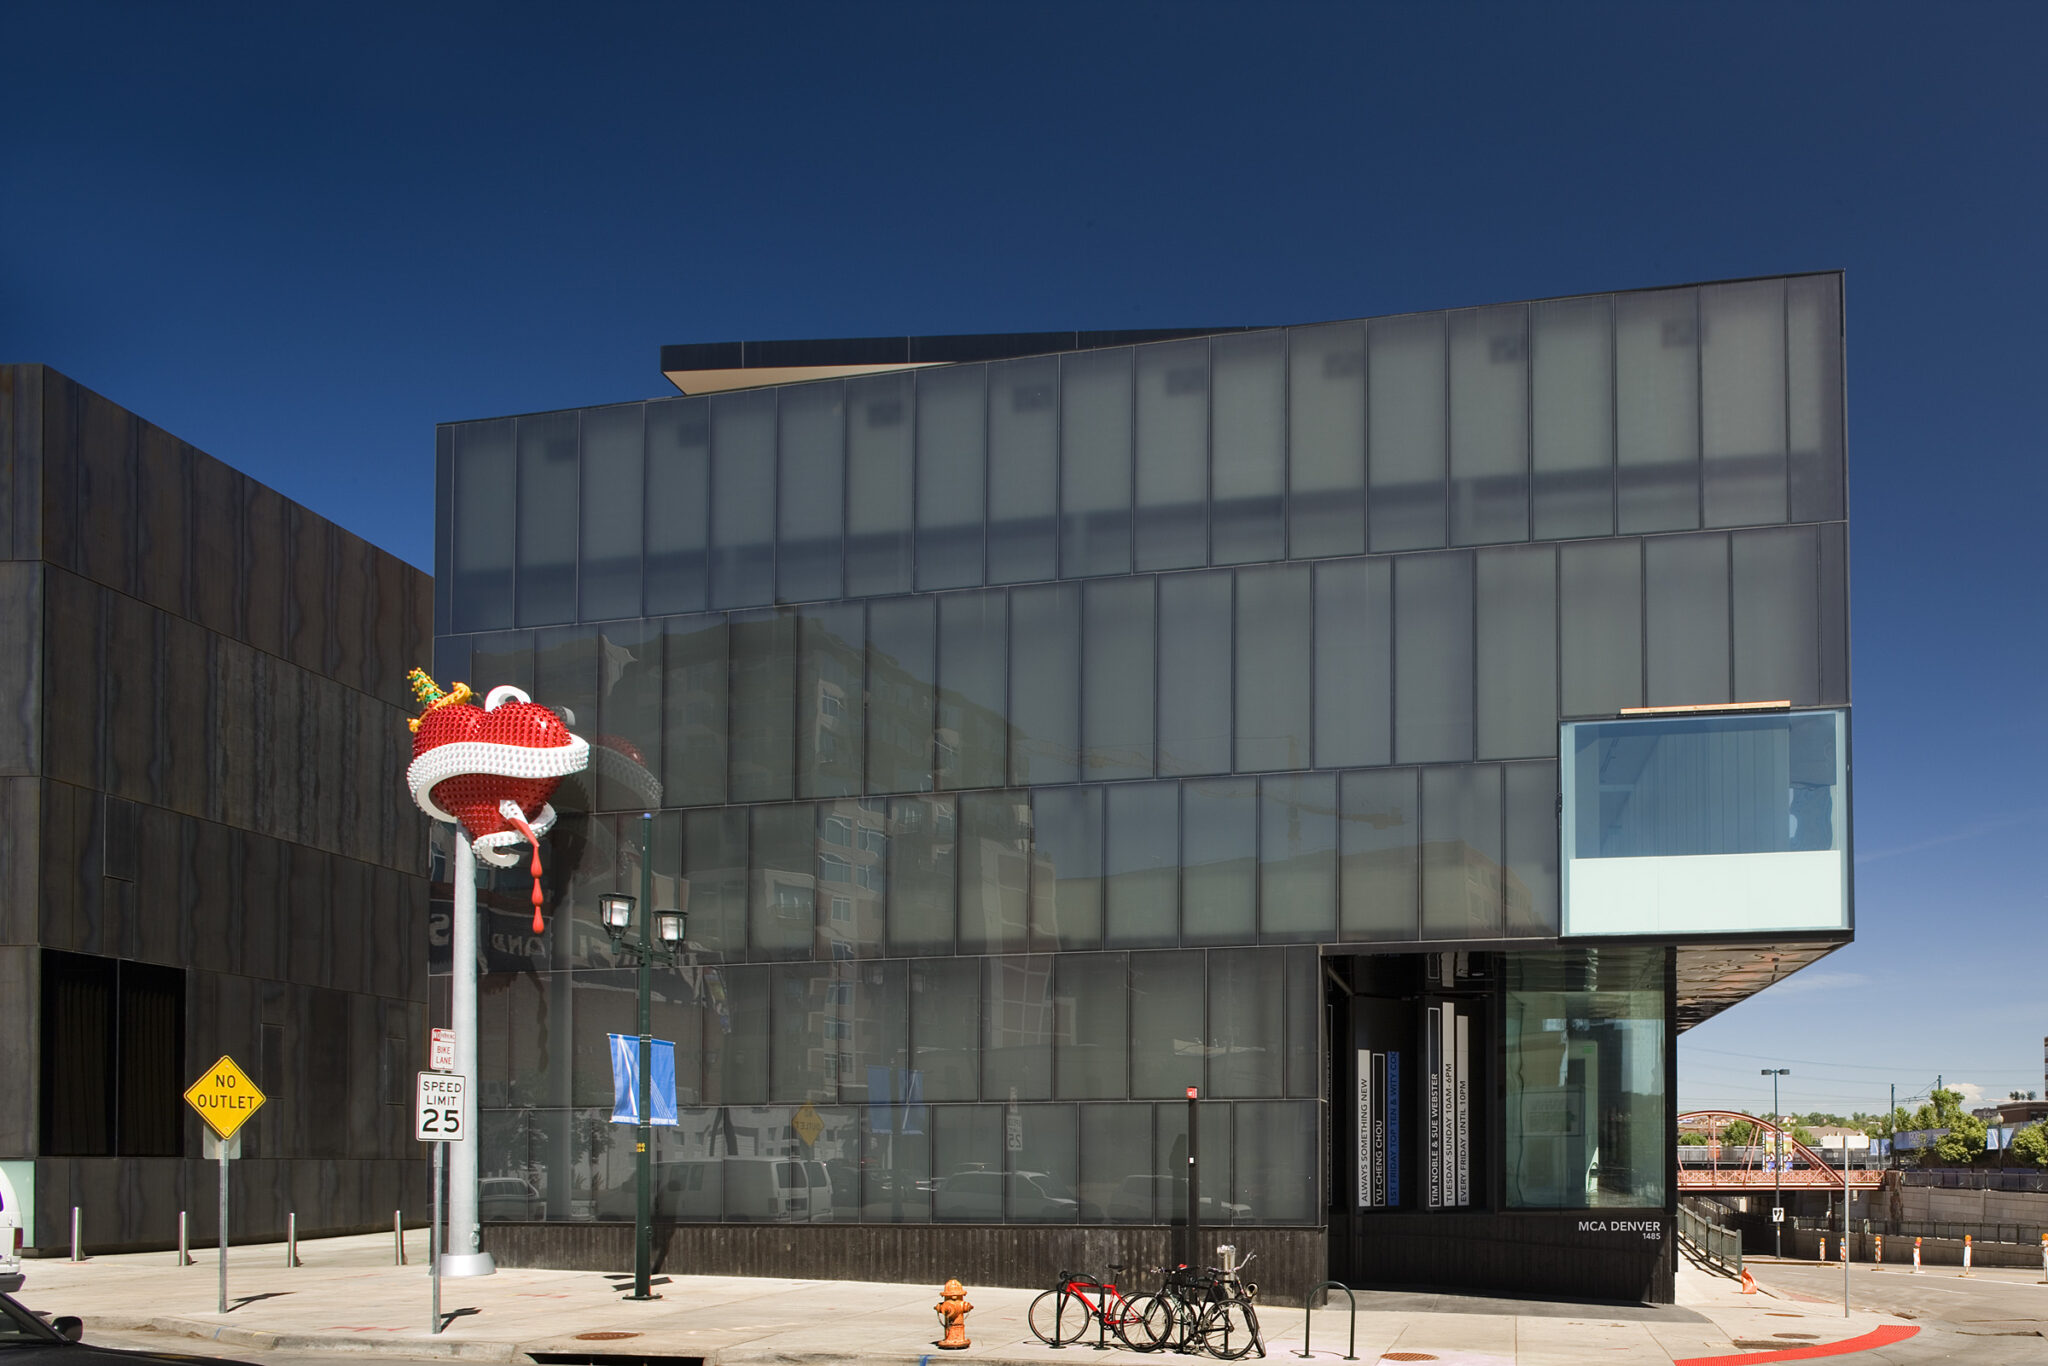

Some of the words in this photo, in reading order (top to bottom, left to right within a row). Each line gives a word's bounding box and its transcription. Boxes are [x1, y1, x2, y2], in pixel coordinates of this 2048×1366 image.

[437, 1045, 451, 1055] BIKE
[436, 1056, 452, 1065] LANE
[216, 1074, 236, 1088] NO
[423, 1081, 462, 1093] SPEED
[197, 1094, 255, 1109] OUTLET
[426, 1095, 457, 1106] LIMIT
[1431, 1073, 1439, 1118] WEBSTER
[1459, 1080, 1467, 1105] 10PM
[422, 1108, 460, 1133] 25
[1431, 1119, 1439, 1139] SUE
[1459, 1109, 1467, 1135] UNTIL
[1375, 1120, 1383, 1149] CHOU
[1459, 1138, 1467, 1171] FRIDAY
[1375, 1150, 1383, 1203] YU-CHENG
[1431, 1150, 1439, 1183] NOBLE
[1431, 1185, 1439, 1203] TIM
[1459, 1173, 1467, 1202] EVERY
[1578, 1221, 1607, 1232] MCA
[1610, 1221, 1661, 1232] DENVER
[1642, 1232, 1661, 1240] 1485
